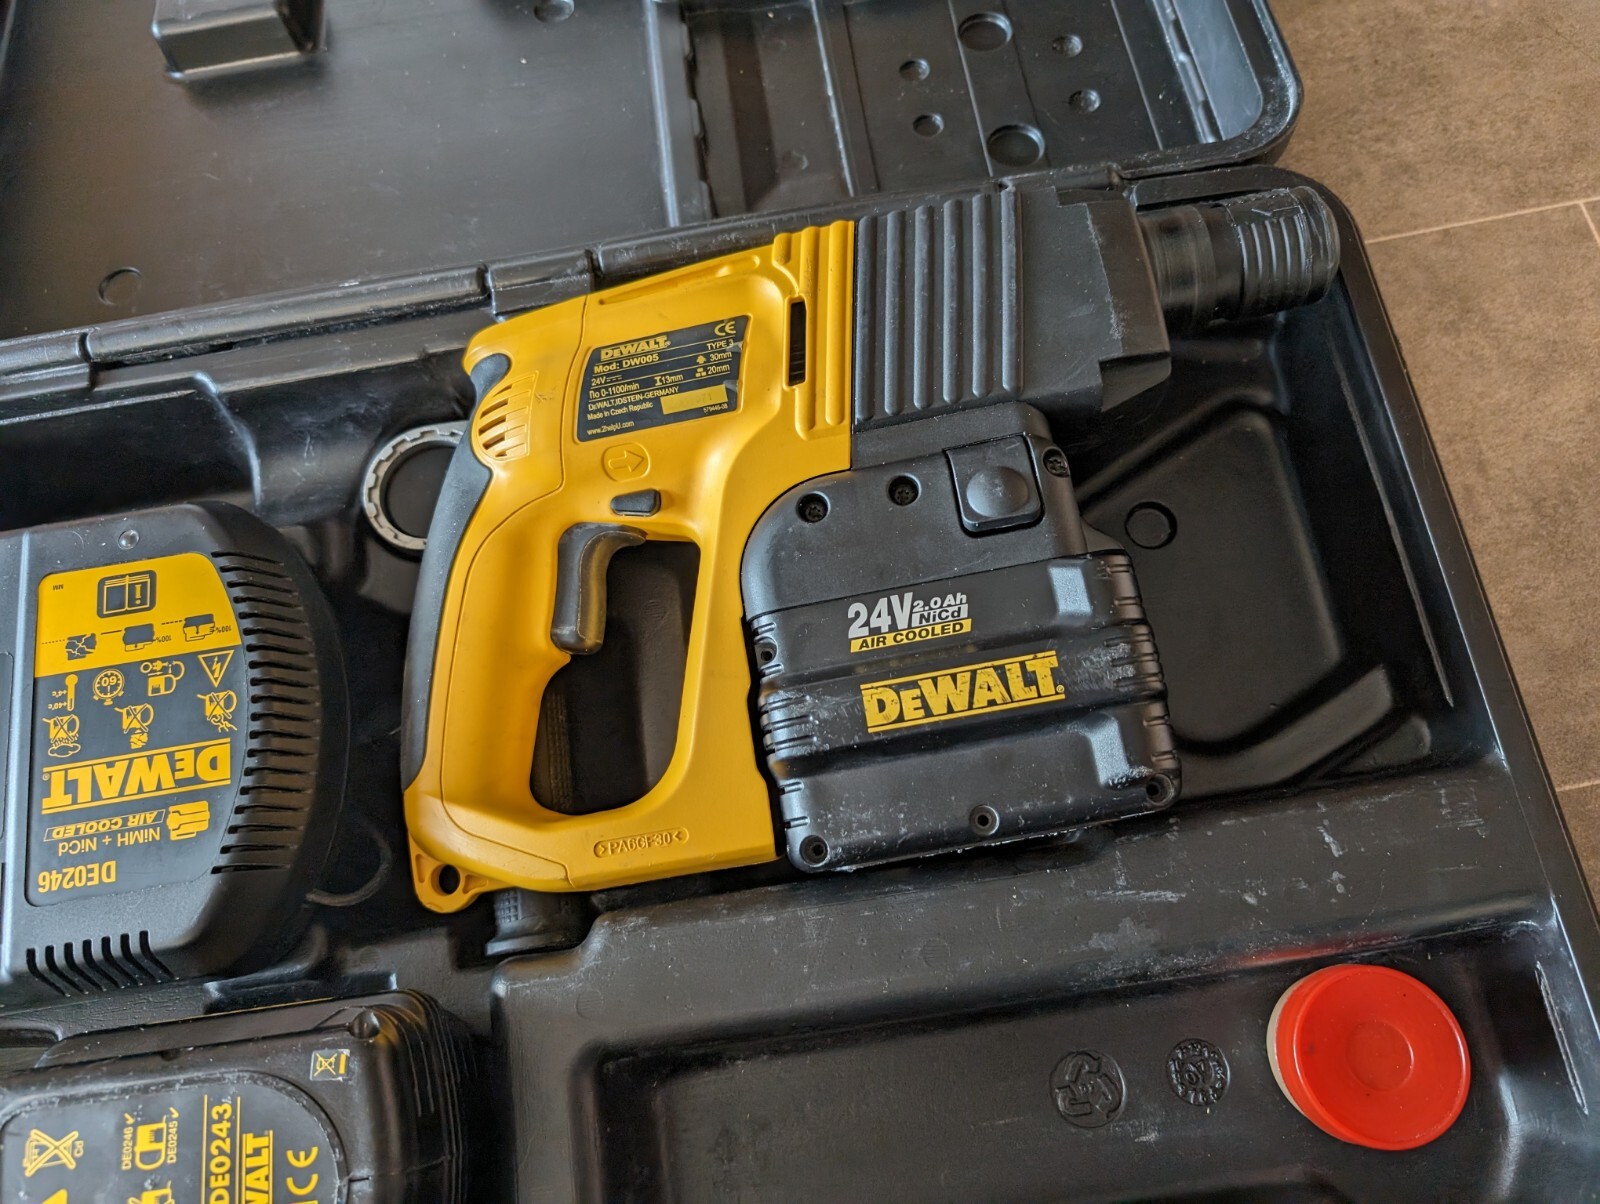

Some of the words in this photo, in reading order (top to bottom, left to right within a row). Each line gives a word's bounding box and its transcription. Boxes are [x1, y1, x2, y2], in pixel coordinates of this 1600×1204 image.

[714, 321, 736, 336] CE
[706, 341, 727, 351] TYPE
[593, 362, 620, 374] Mod:
[622, 353, 660, 368] DW005
[709, 351, 732, 362] 30mm
[707, 363, 730, 375] 20mm
[587, 408, 604, 420] Made
[610, 404, 628, 415] Czech
[628, 401, 654, 414] Republic
[848, 591, 914, 639] 24V
[918, 606, 962, 625] NiCd
[858, 636, 887, 650] AIR
[892, 622, 965, 644] COOLED
[101, 676, 116, 686] 60
[51, 817, 122, 840] COOLED
[127, 811, 158, 828] AIR
[58, 836, 97, 856] NiCd
[117, 827, 161, 848] NiMH
[37, 860, 117, 894] DE0246
[209, 1103, 232, 1204] DE0243
[286, 1146, 319, 1196] CE
